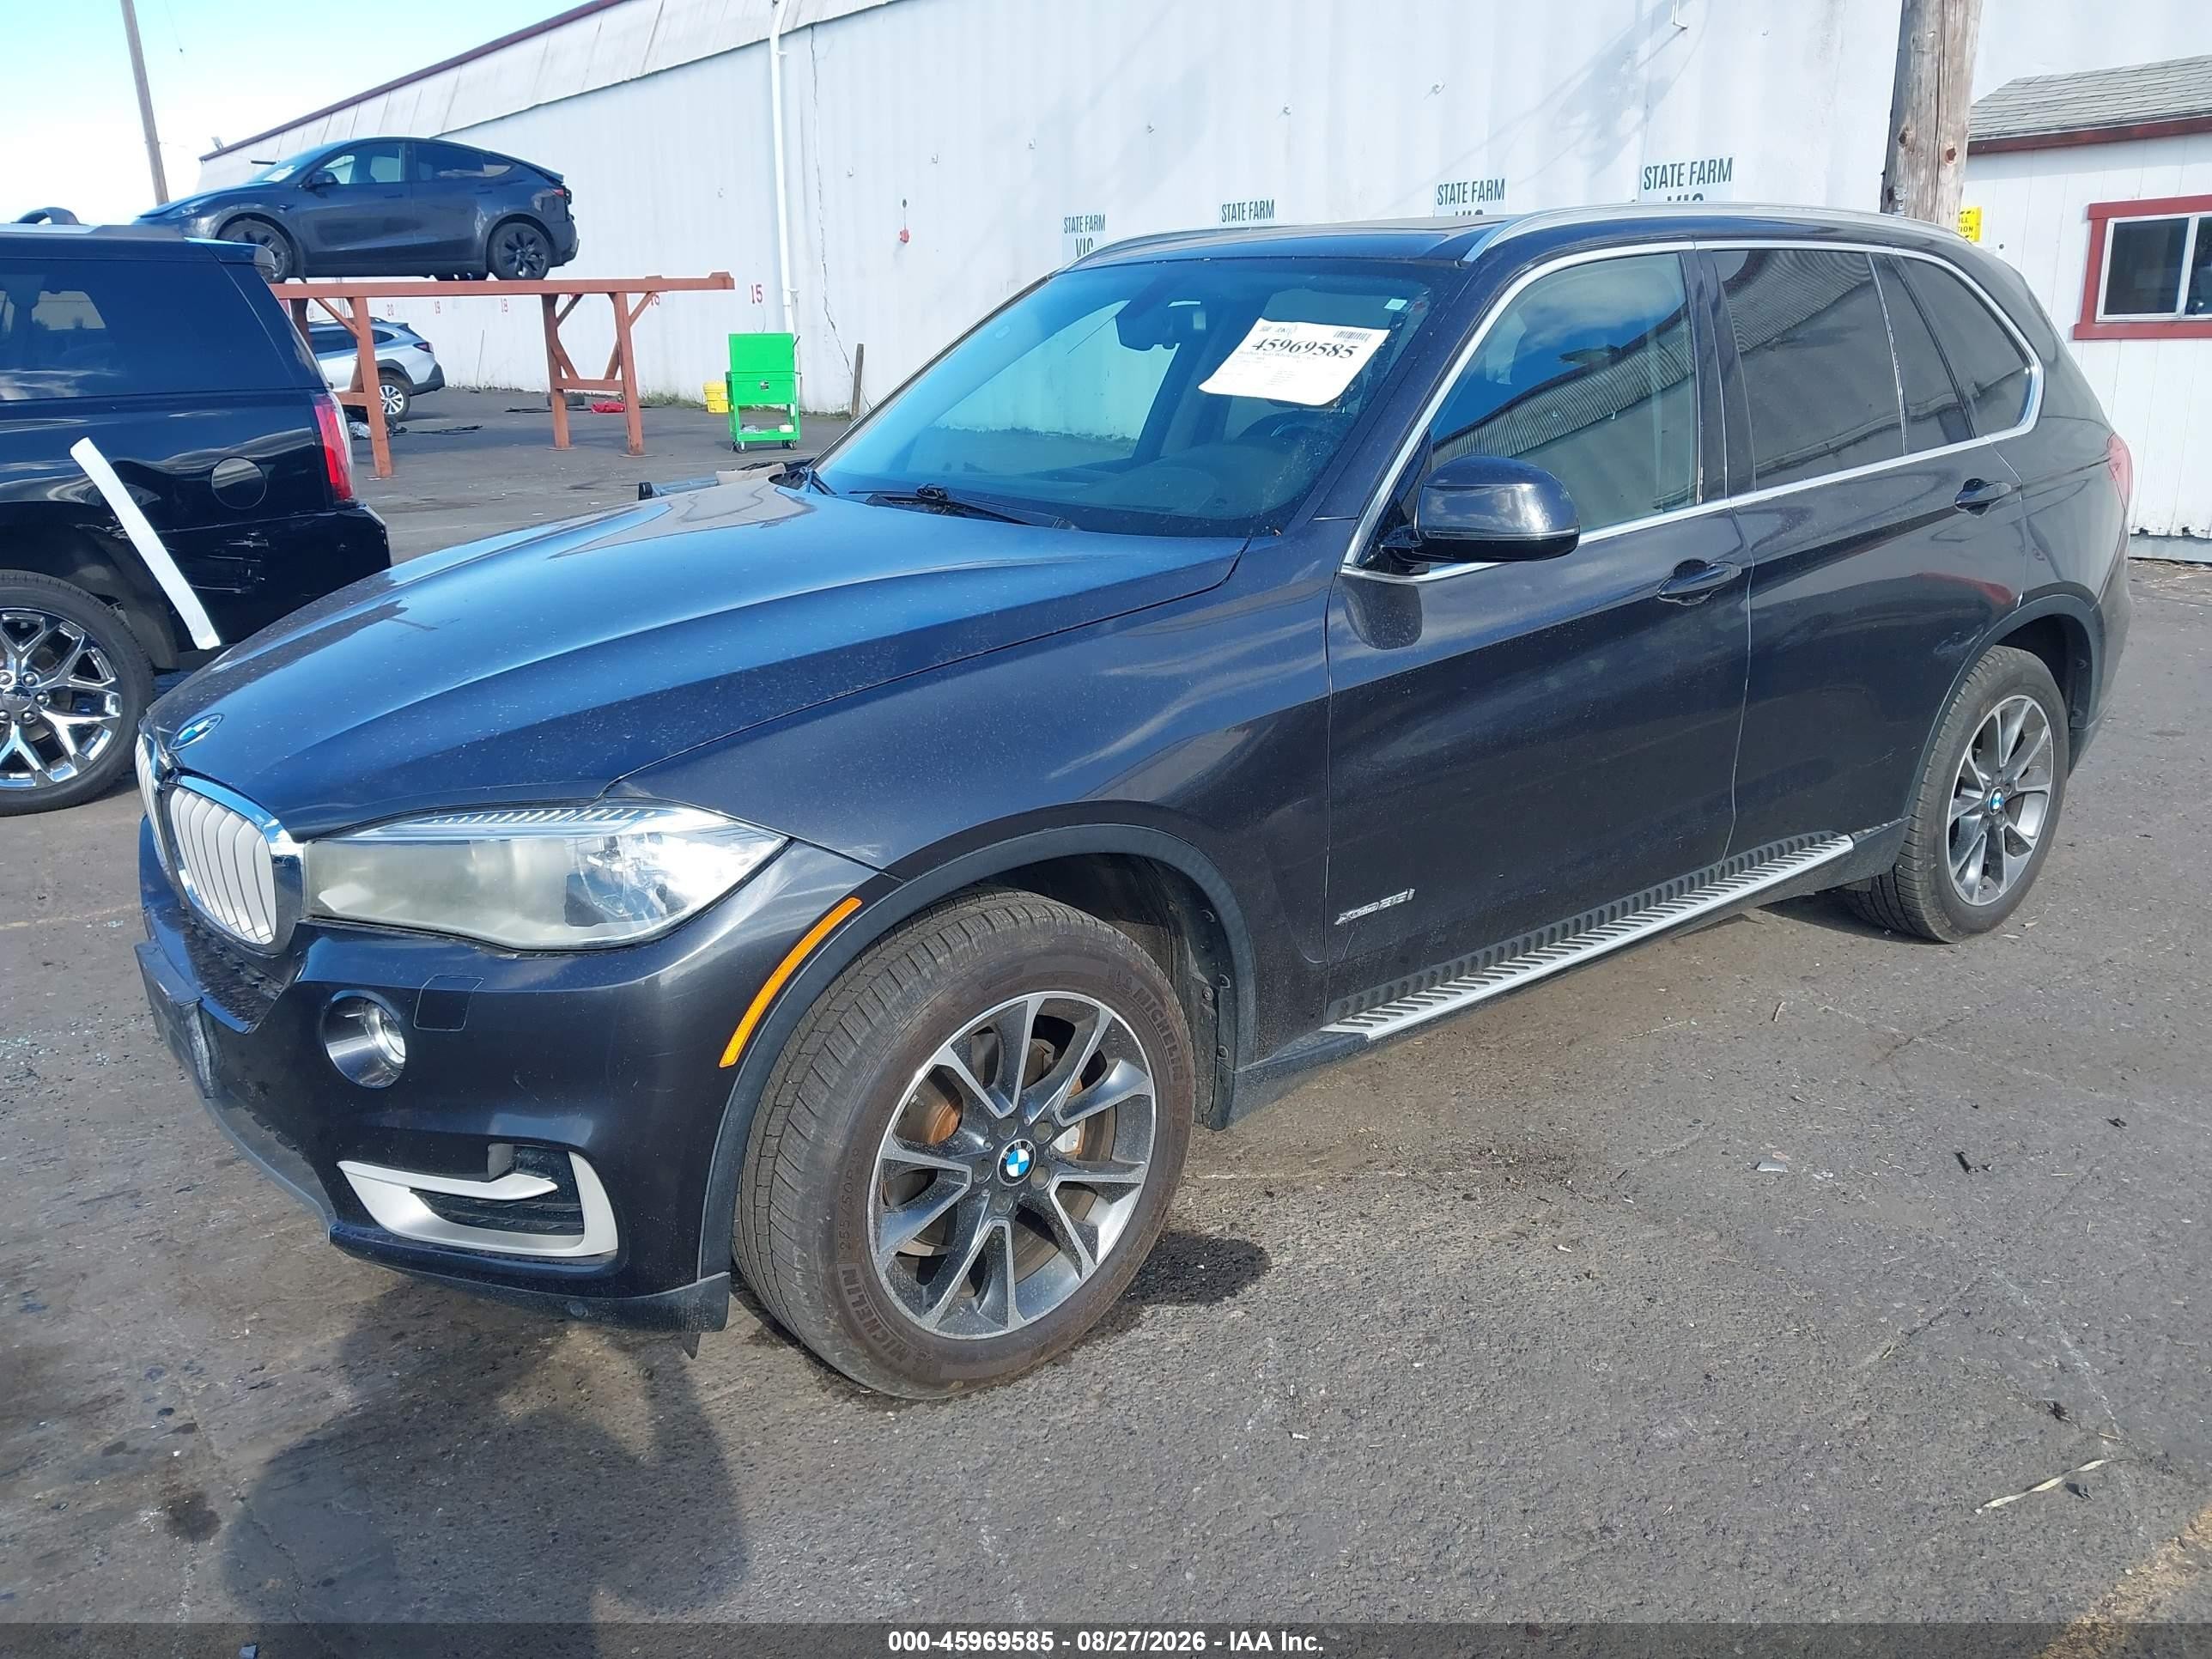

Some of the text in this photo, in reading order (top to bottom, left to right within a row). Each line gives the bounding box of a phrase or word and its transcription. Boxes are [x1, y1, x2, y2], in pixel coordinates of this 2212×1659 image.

[1644, 157, 1733, 190] STATE FARM
[1437, 178, 1505, 206] STATE FARM
[1221, 199, 1275, 223] STATE FARM
[1063, 214, 1106, 234] STATE FARM
[750, 284, 763, 305] 15
[1251, 337, 1360, 360] 45969585
[841, 1268, 908, 1362] MICHELIN
